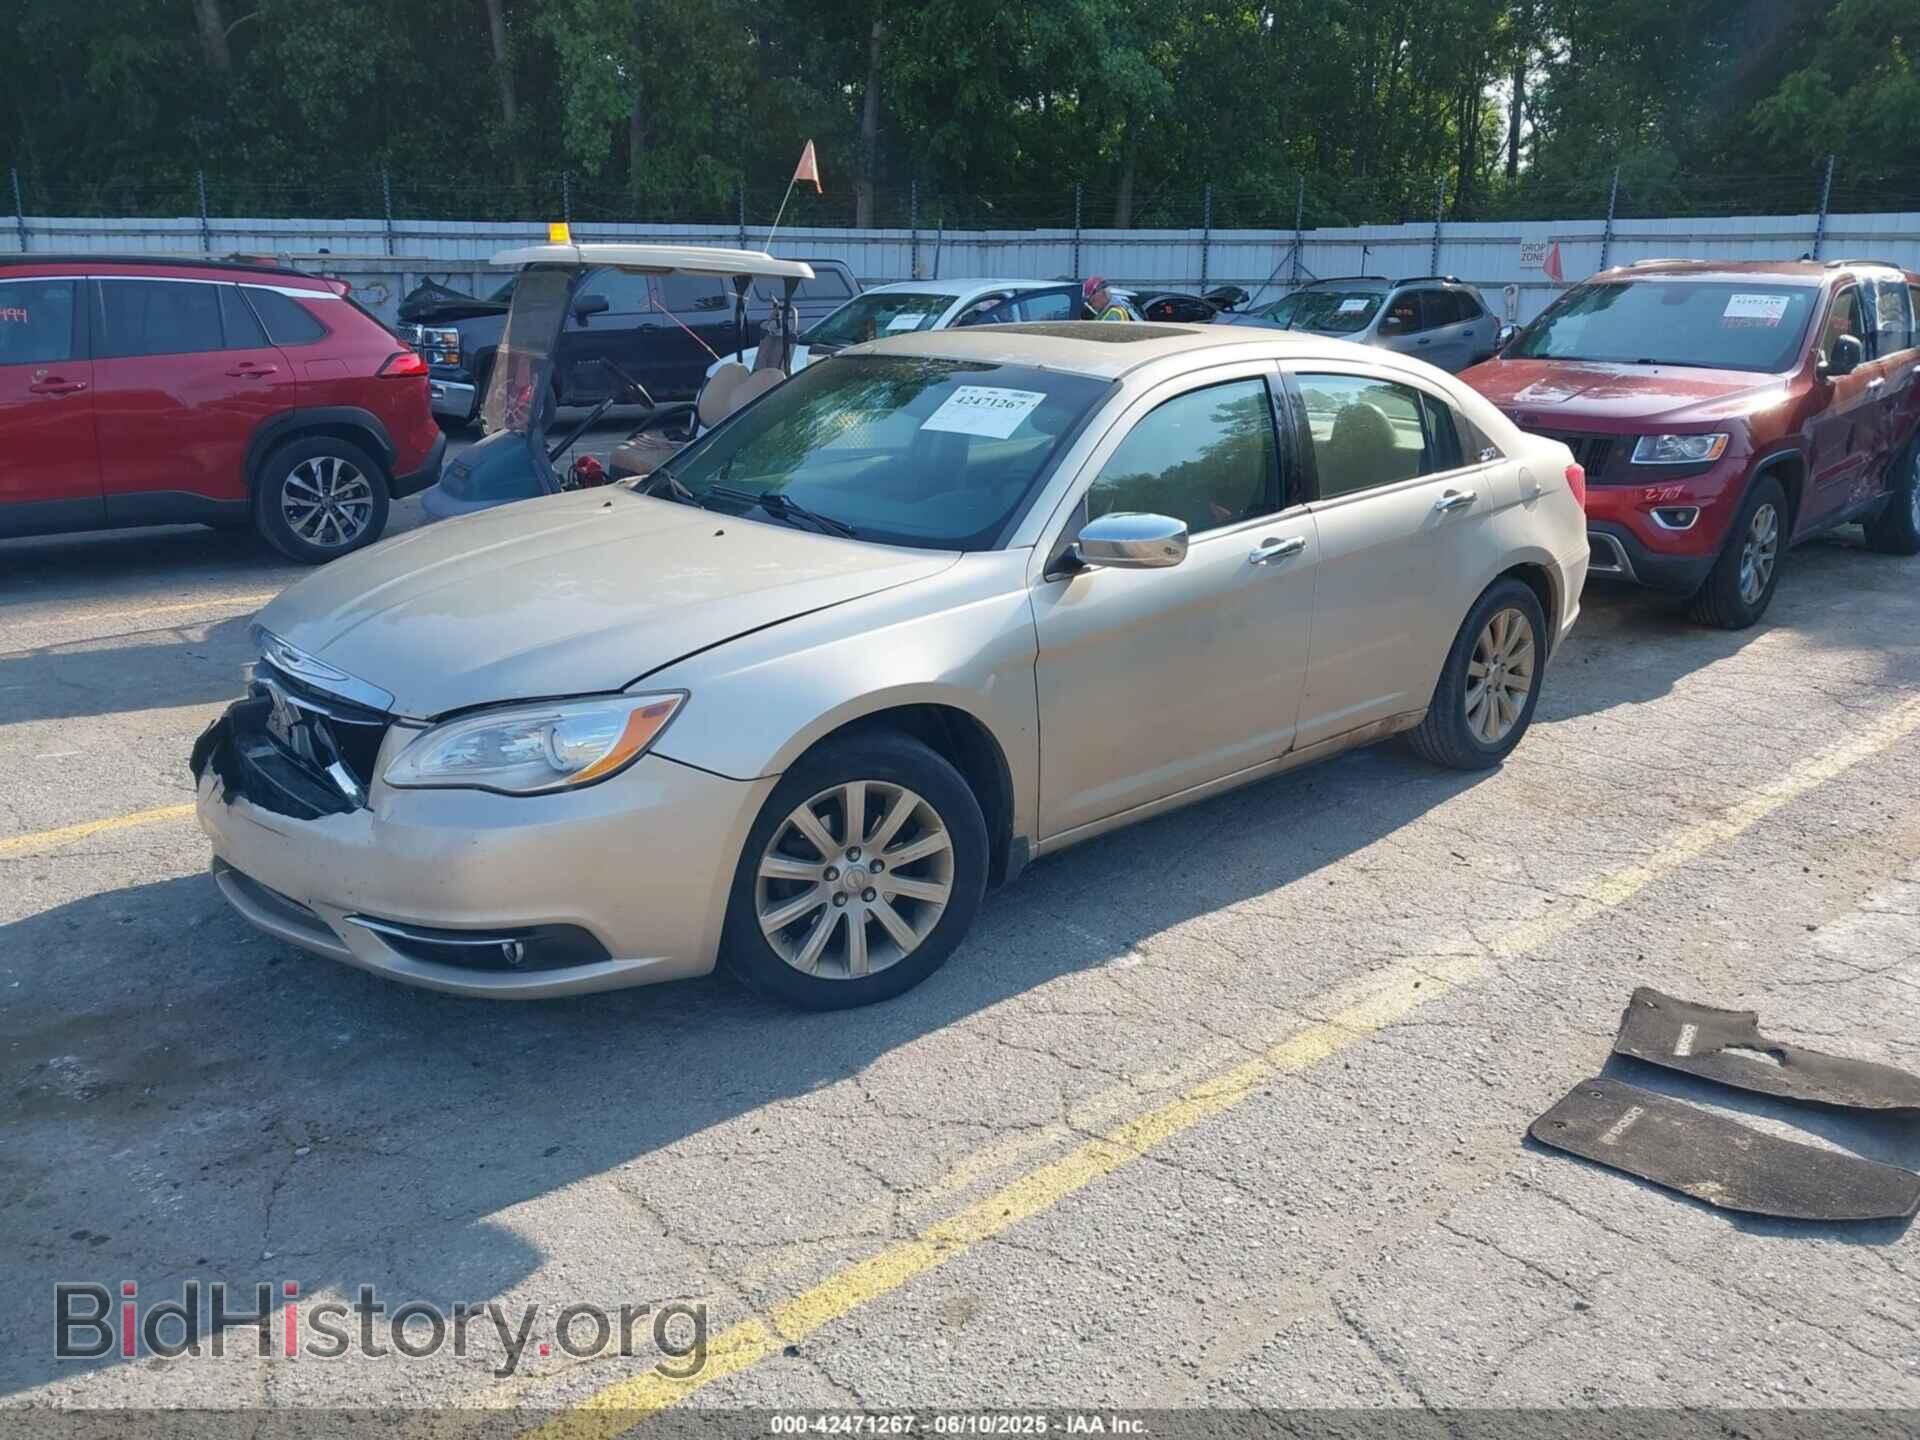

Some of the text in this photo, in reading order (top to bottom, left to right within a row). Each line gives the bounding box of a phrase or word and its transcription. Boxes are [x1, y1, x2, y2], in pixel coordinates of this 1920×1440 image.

[1521, 242, 1546, 252] DROP
[1520, 252, 1546, 262] ZONE
[954, 396, 1027, 410] 42471267
